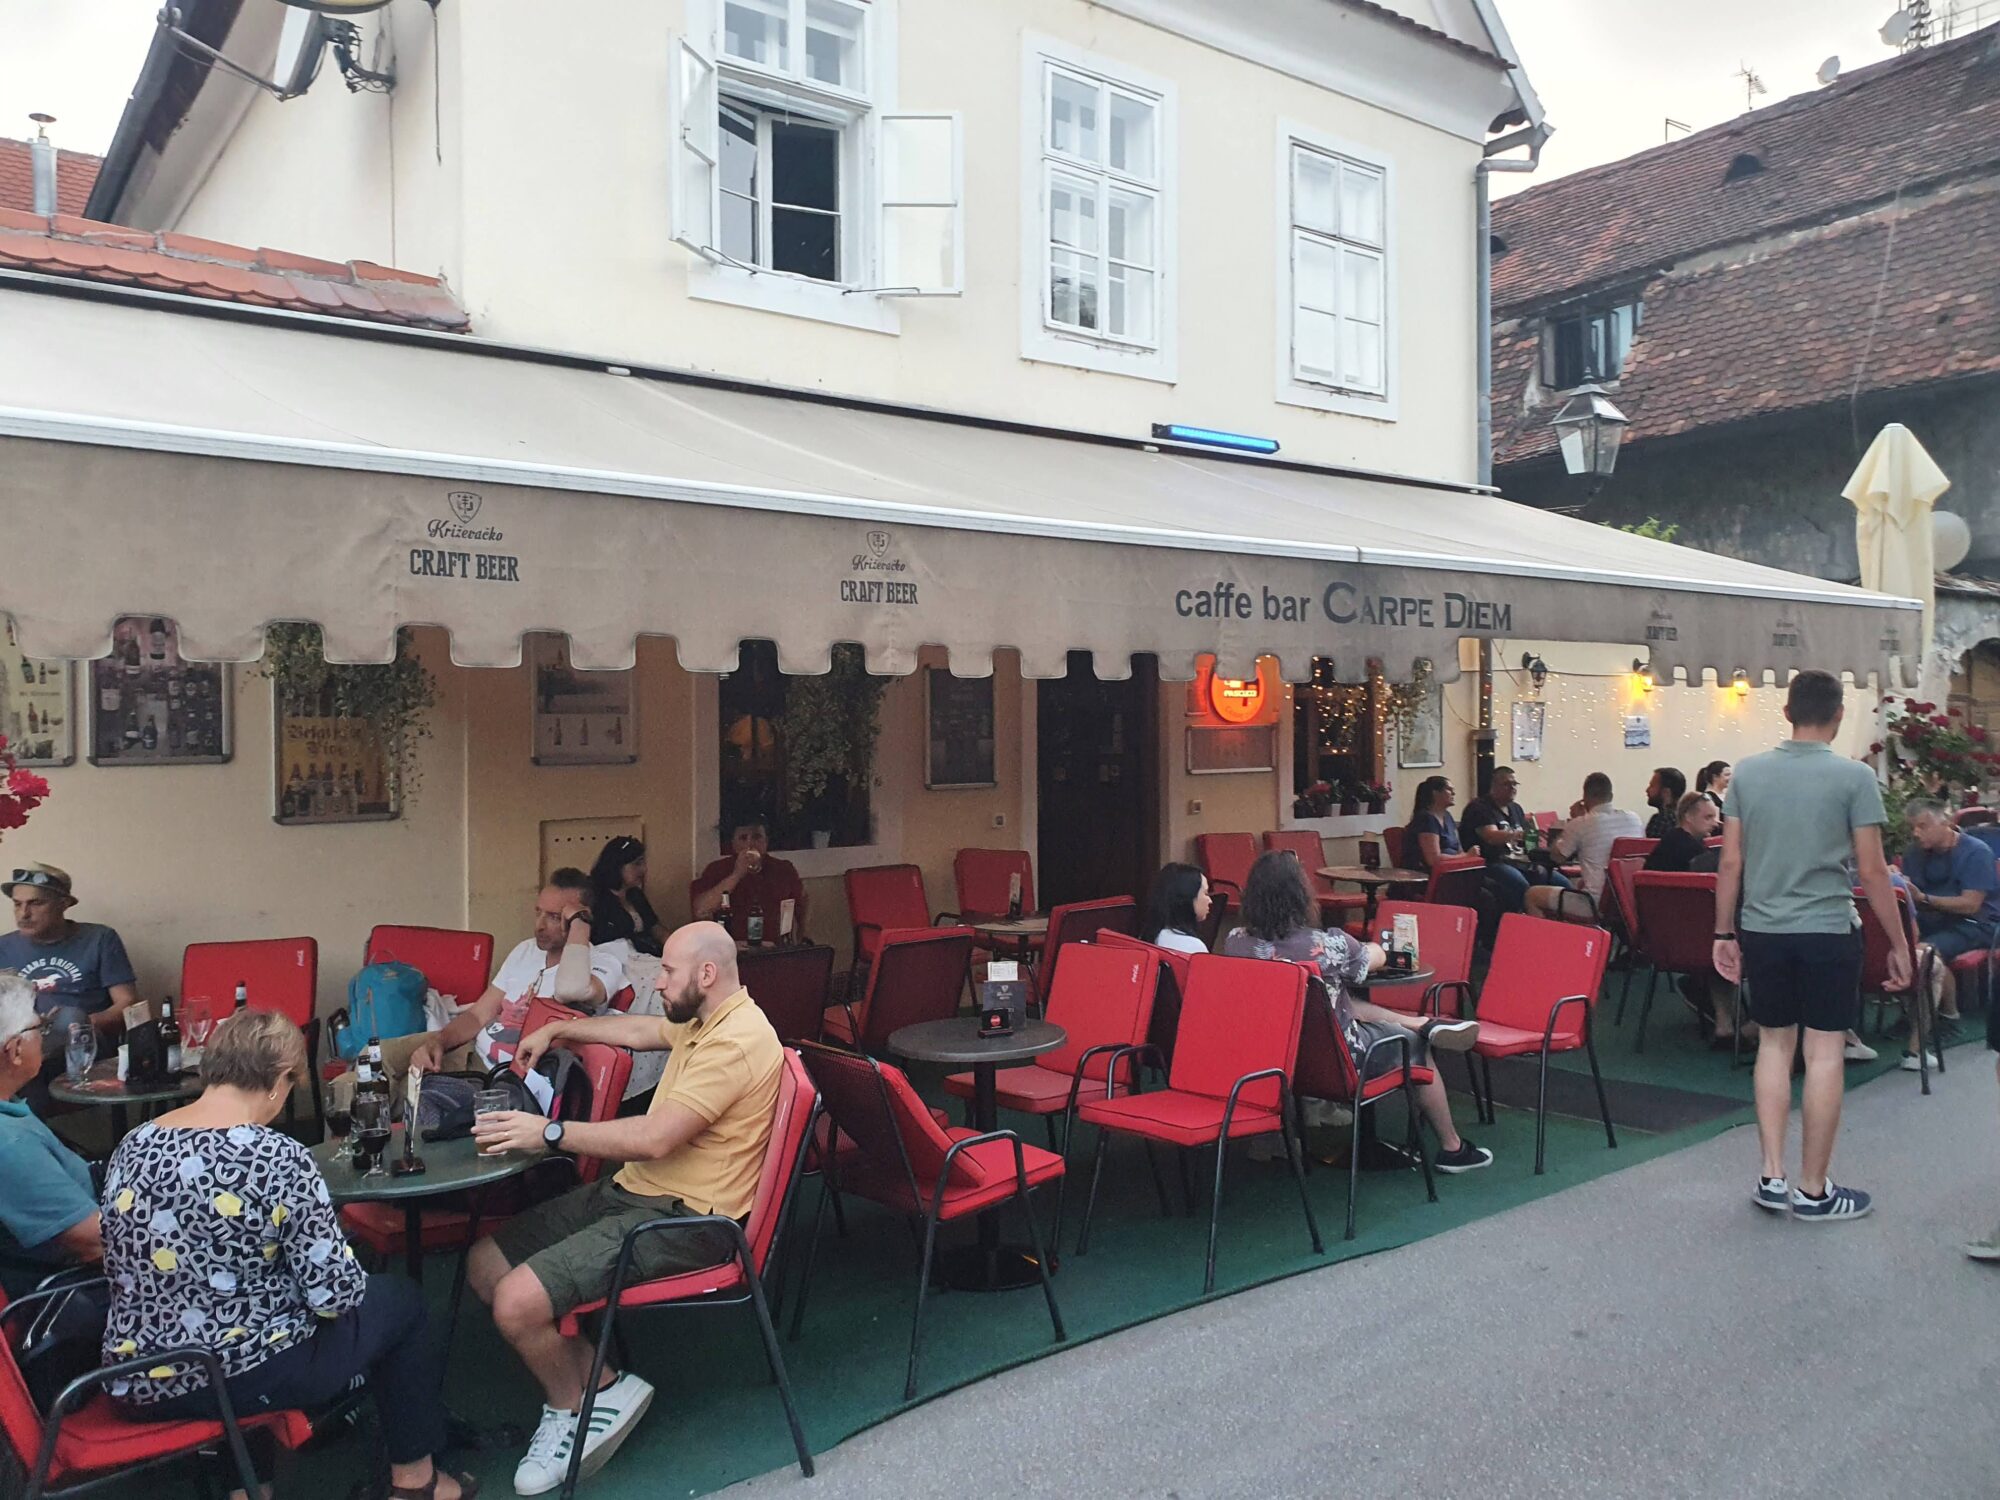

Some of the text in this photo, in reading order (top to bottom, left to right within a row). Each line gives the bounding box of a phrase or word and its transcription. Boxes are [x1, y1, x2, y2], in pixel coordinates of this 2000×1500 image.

[428, 519, 503, 541] Križevačko
[410, 549, 520, 581] CRAFT BEER
[840, 580, 919, 605] CRAFT BEER
[1175, 581, 1512, 631] caffe bar CARPE DIEM
[50, 957, 83, 982] ORIGINAL
